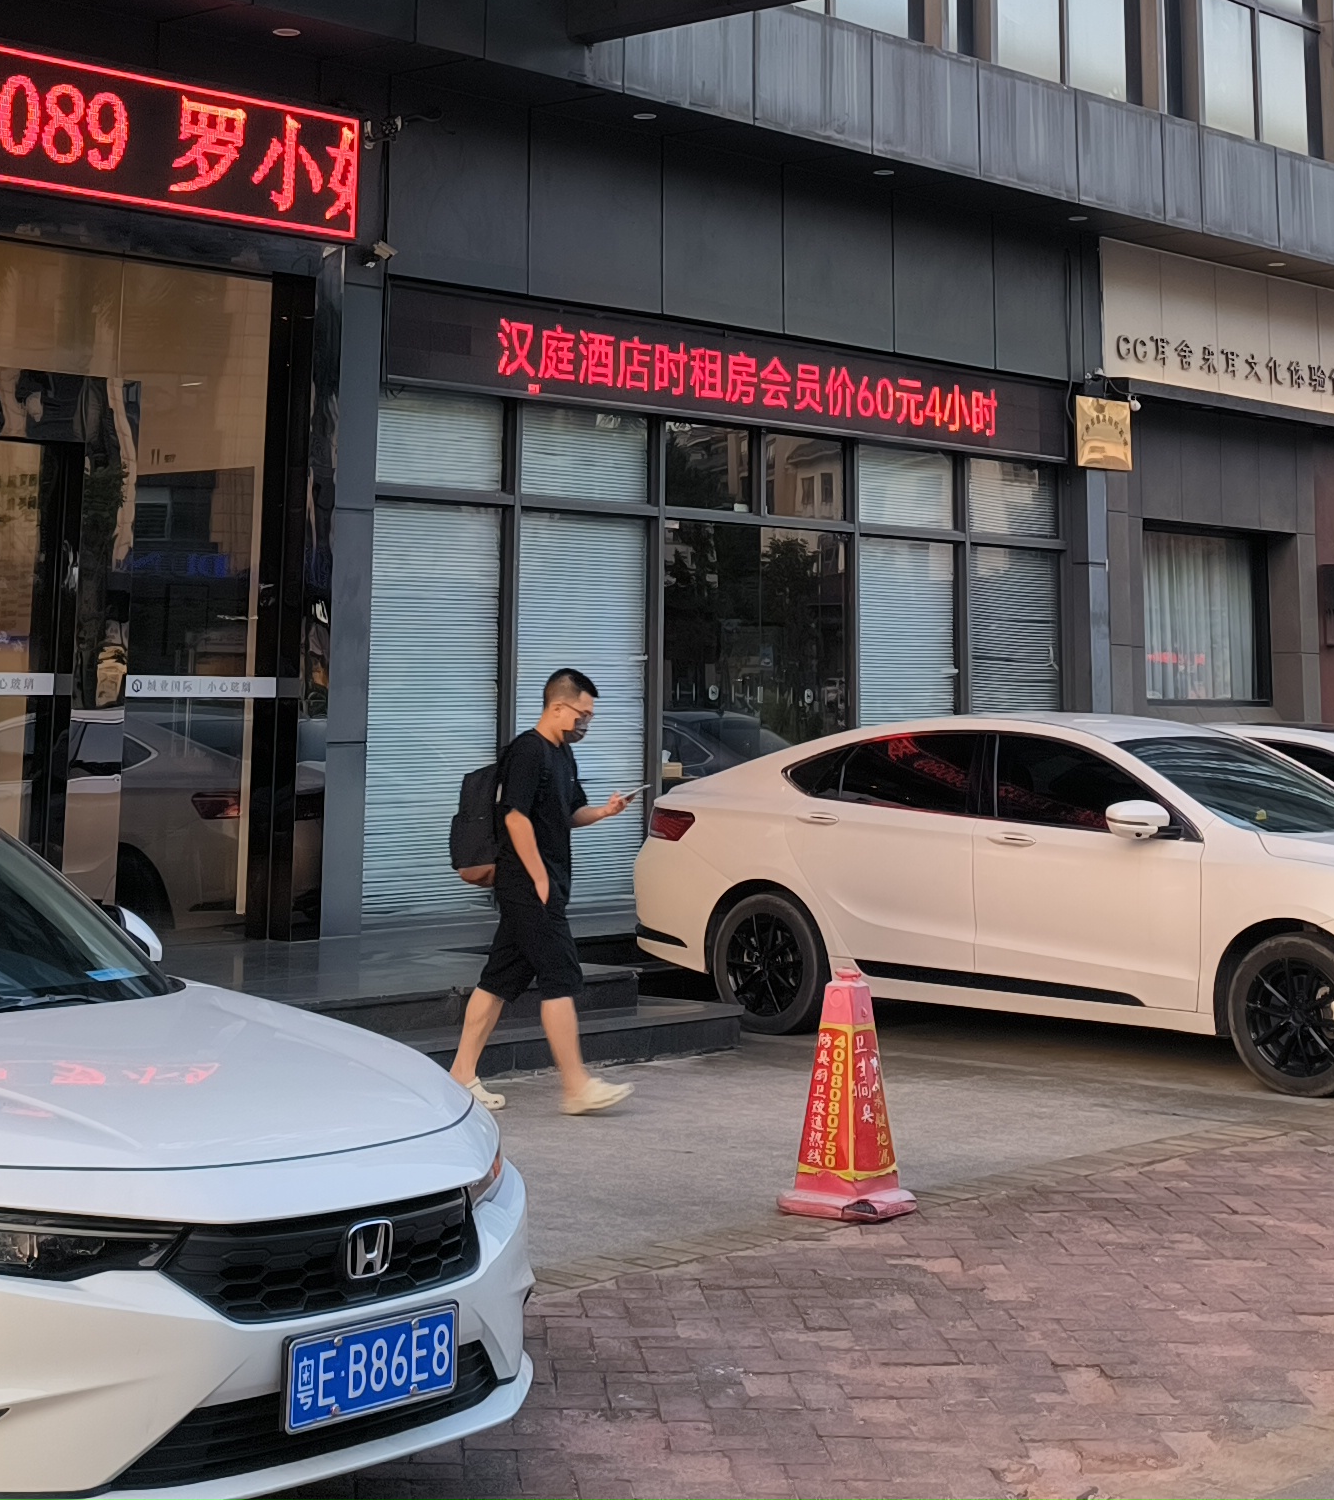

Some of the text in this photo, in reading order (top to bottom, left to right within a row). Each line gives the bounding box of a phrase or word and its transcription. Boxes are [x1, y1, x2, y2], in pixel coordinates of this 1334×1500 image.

[498, 318, 998, 437] 汉庭酒店时租房会员价60元4小时
[824, 1035, 847, 1168] 4008080750
